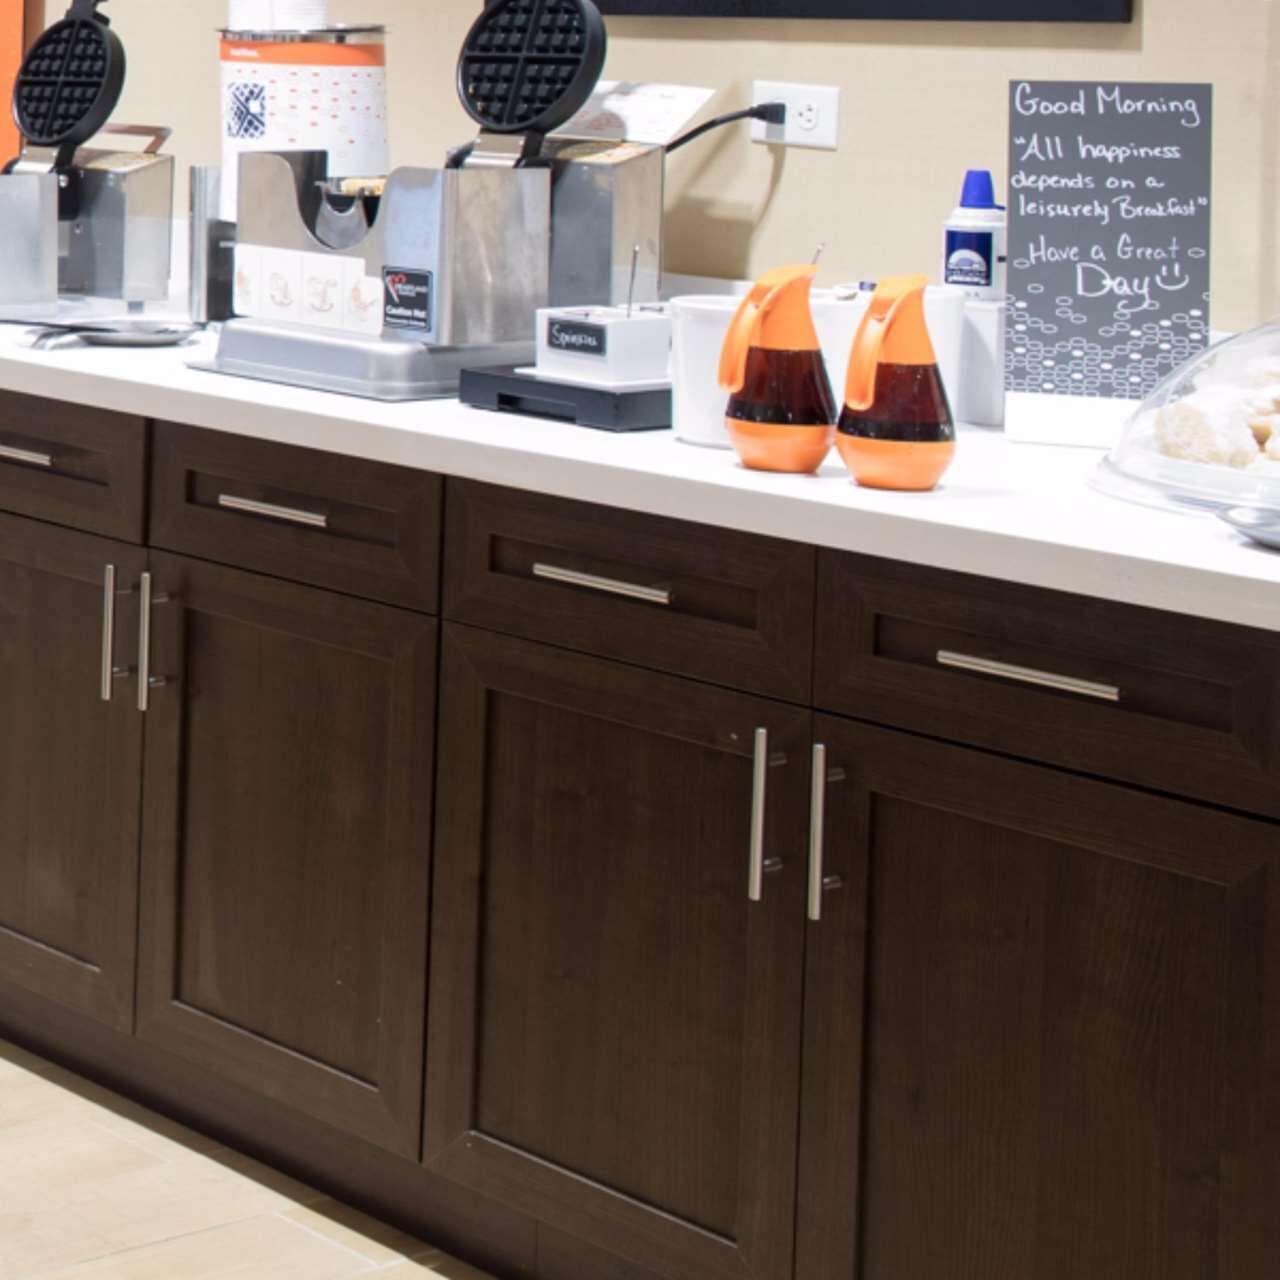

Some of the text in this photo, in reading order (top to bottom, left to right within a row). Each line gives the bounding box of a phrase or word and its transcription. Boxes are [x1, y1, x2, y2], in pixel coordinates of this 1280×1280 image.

[1015, 83, 1201, 128] Good Morning
[1076, 134, 1182, 164] happiness
[1011, 170, 1165, 192] depends on a
[1019, 194, 1111, 225] leisurely
[1029, 233, 1180, 265] Have a Great
[1076, 262, 1151, 312] Day
